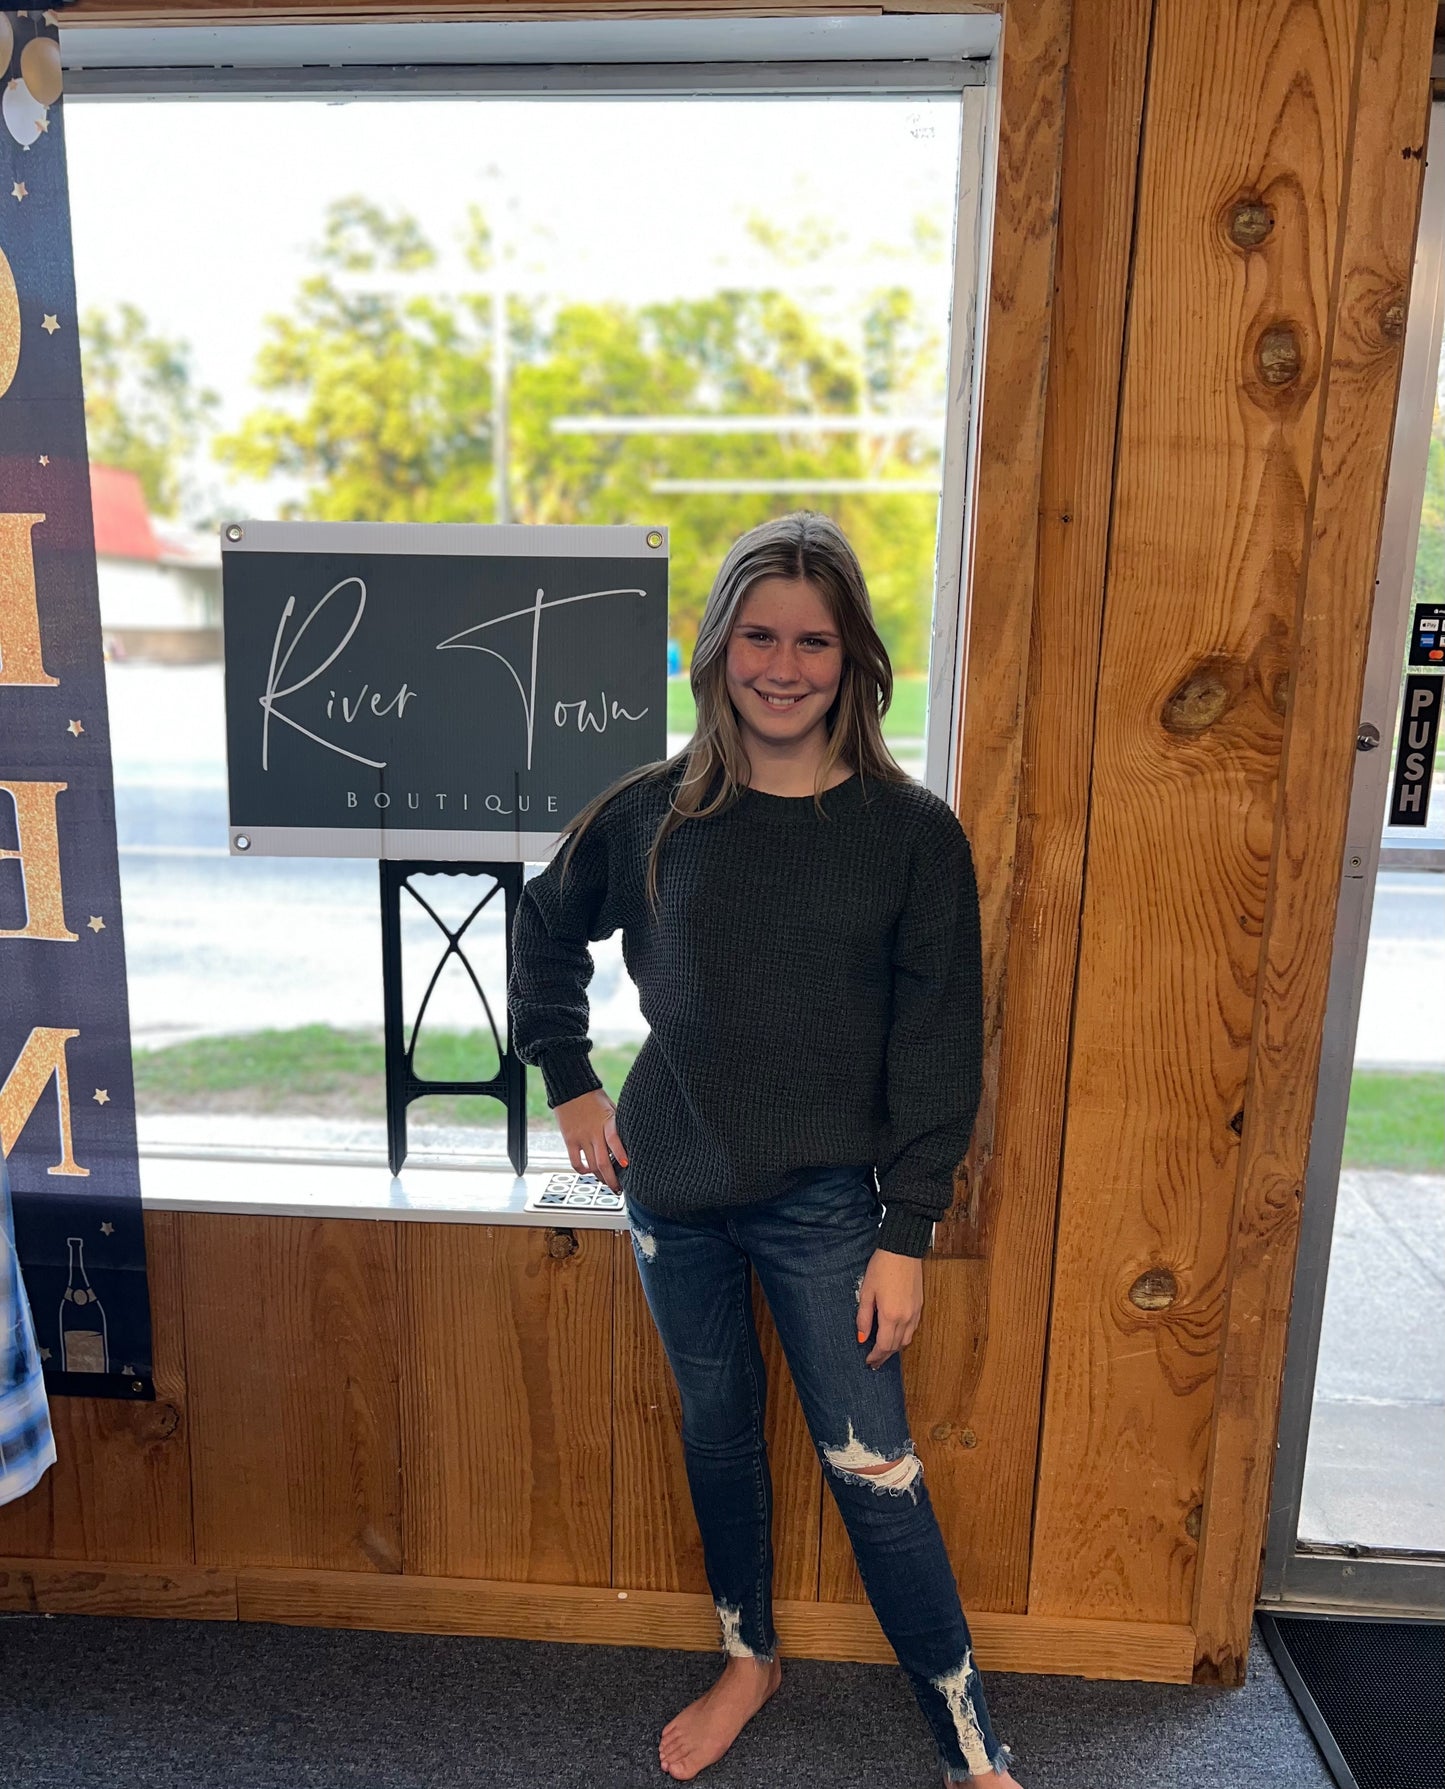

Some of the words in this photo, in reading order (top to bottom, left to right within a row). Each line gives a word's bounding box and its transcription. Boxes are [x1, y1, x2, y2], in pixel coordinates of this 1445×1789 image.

[259, 576, 417, 771] River
[436, 588, 648, 771] Town
[346, 791, 558, 815] BOUTIQUE
[1399, 689, 1434, 812] PUSH
